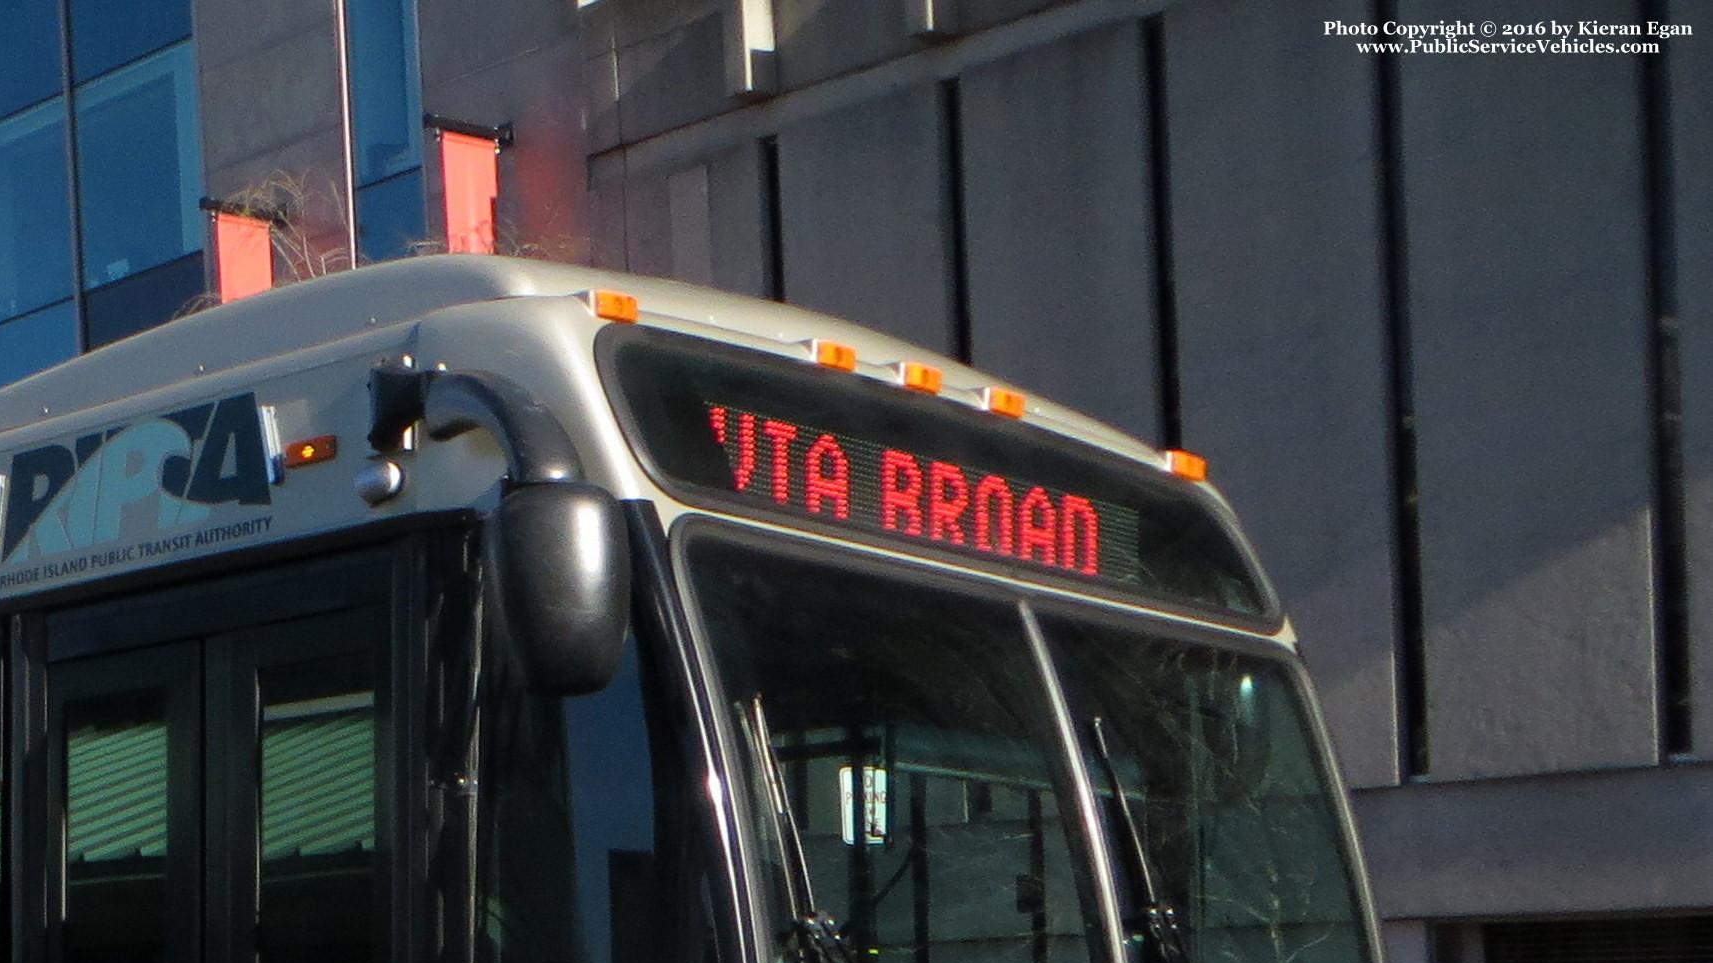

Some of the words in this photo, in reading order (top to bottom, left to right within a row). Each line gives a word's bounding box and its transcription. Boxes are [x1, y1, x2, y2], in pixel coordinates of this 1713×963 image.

[2, 393, 271, 564] RIPTA
[0, 568, 39, 588] RHODE
[44, 557, 87, 578] ISLAND
[91, 548, 133, 567] PUBLIC
[139, 534, 192, 557] TRANSIT
[195, 516, 272, 546] AUTHORITY
